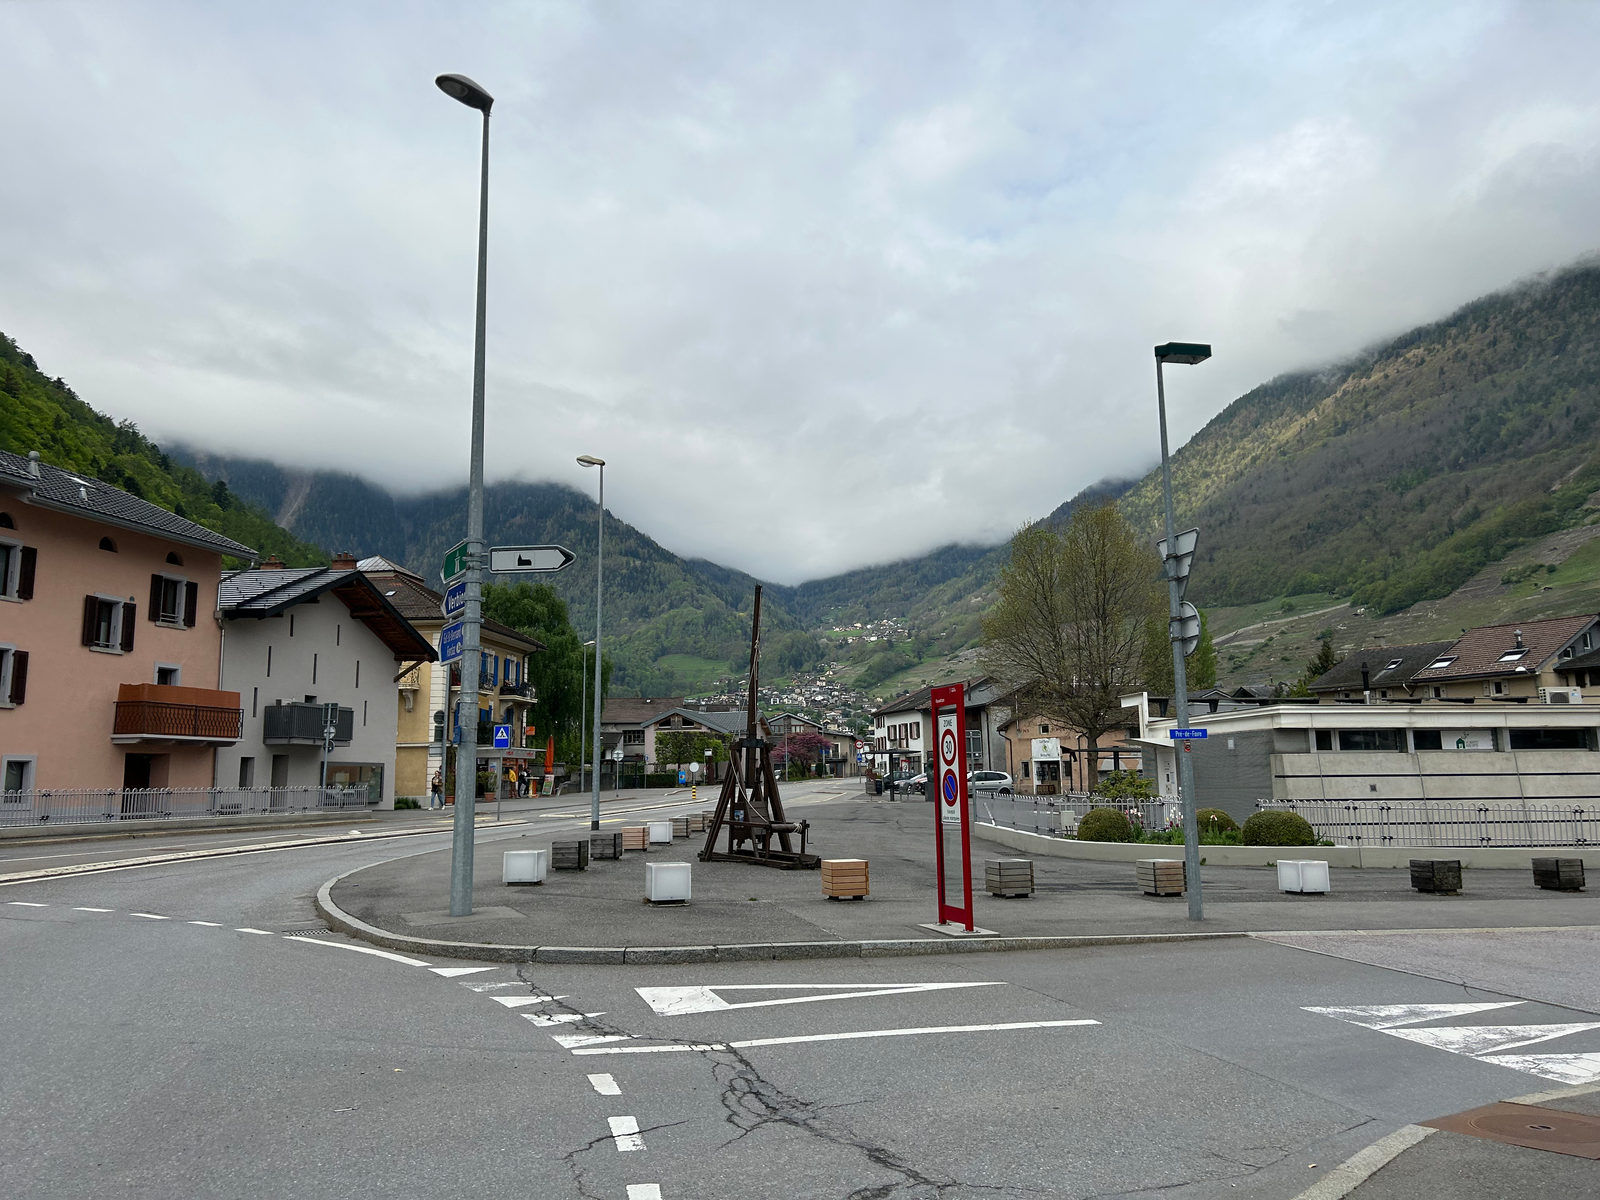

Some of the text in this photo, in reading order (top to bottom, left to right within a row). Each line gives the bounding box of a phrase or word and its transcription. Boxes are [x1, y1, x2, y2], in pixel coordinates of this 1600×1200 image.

[448, 590, 464, 611] Verbie
[943, 719, 953, 727] ZONE
[945, 740, 953, 754] 30
